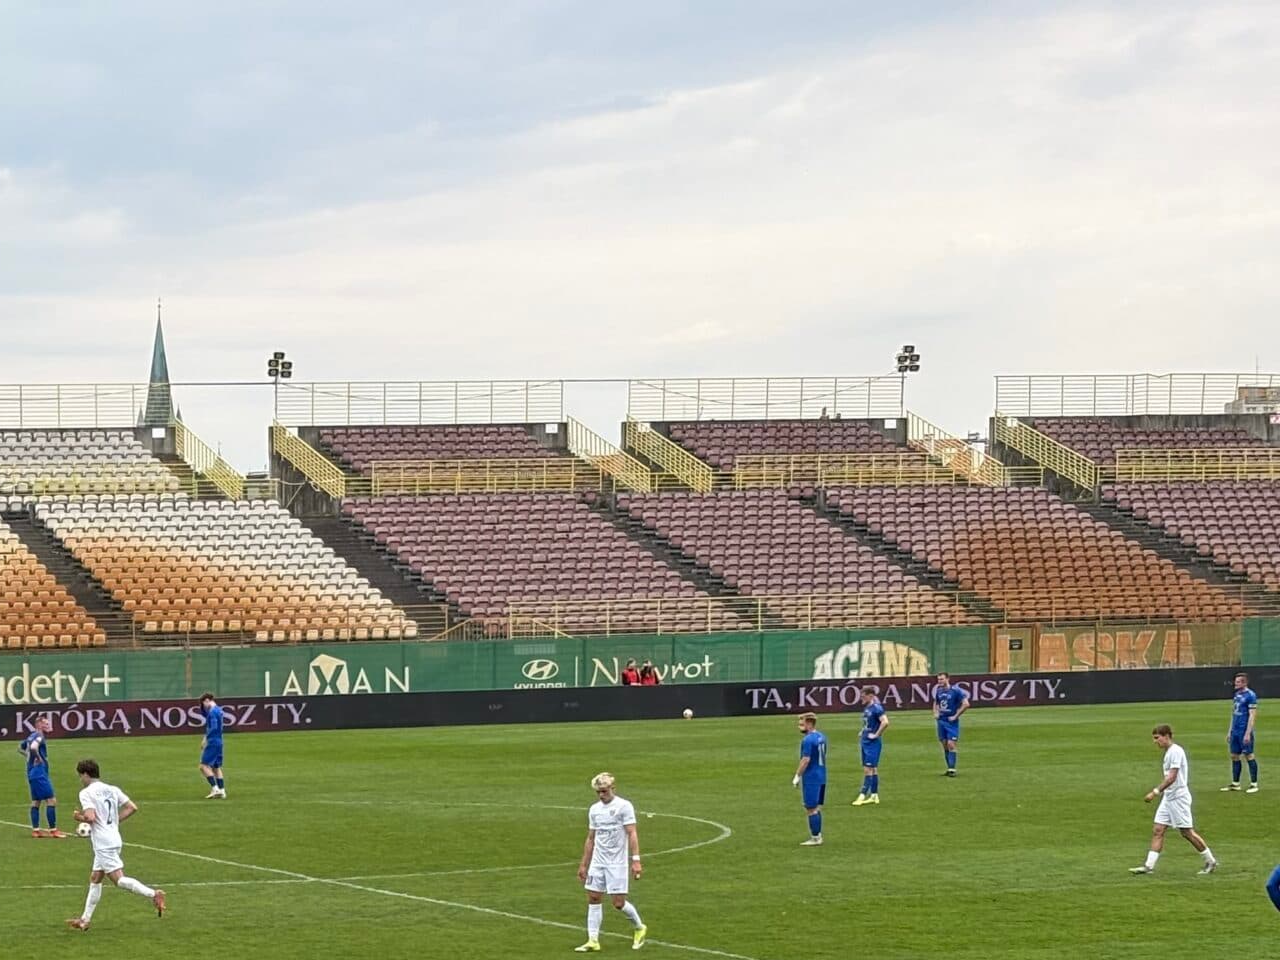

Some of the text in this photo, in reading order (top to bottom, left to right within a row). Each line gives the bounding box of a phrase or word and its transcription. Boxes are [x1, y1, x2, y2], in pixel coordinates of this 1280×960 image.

[813, 640, 929, 679] ACANA
[746, 687, 792, 710] TA,
[911, 679, 1016, 704] NSISZ
[1023, 678, 1066, 699] TY.
[15, 704, 132, 734] KTÓRĄ
[140, 703, 257, 729] NOSSZ
[263, 702, 312, 724] TY.
